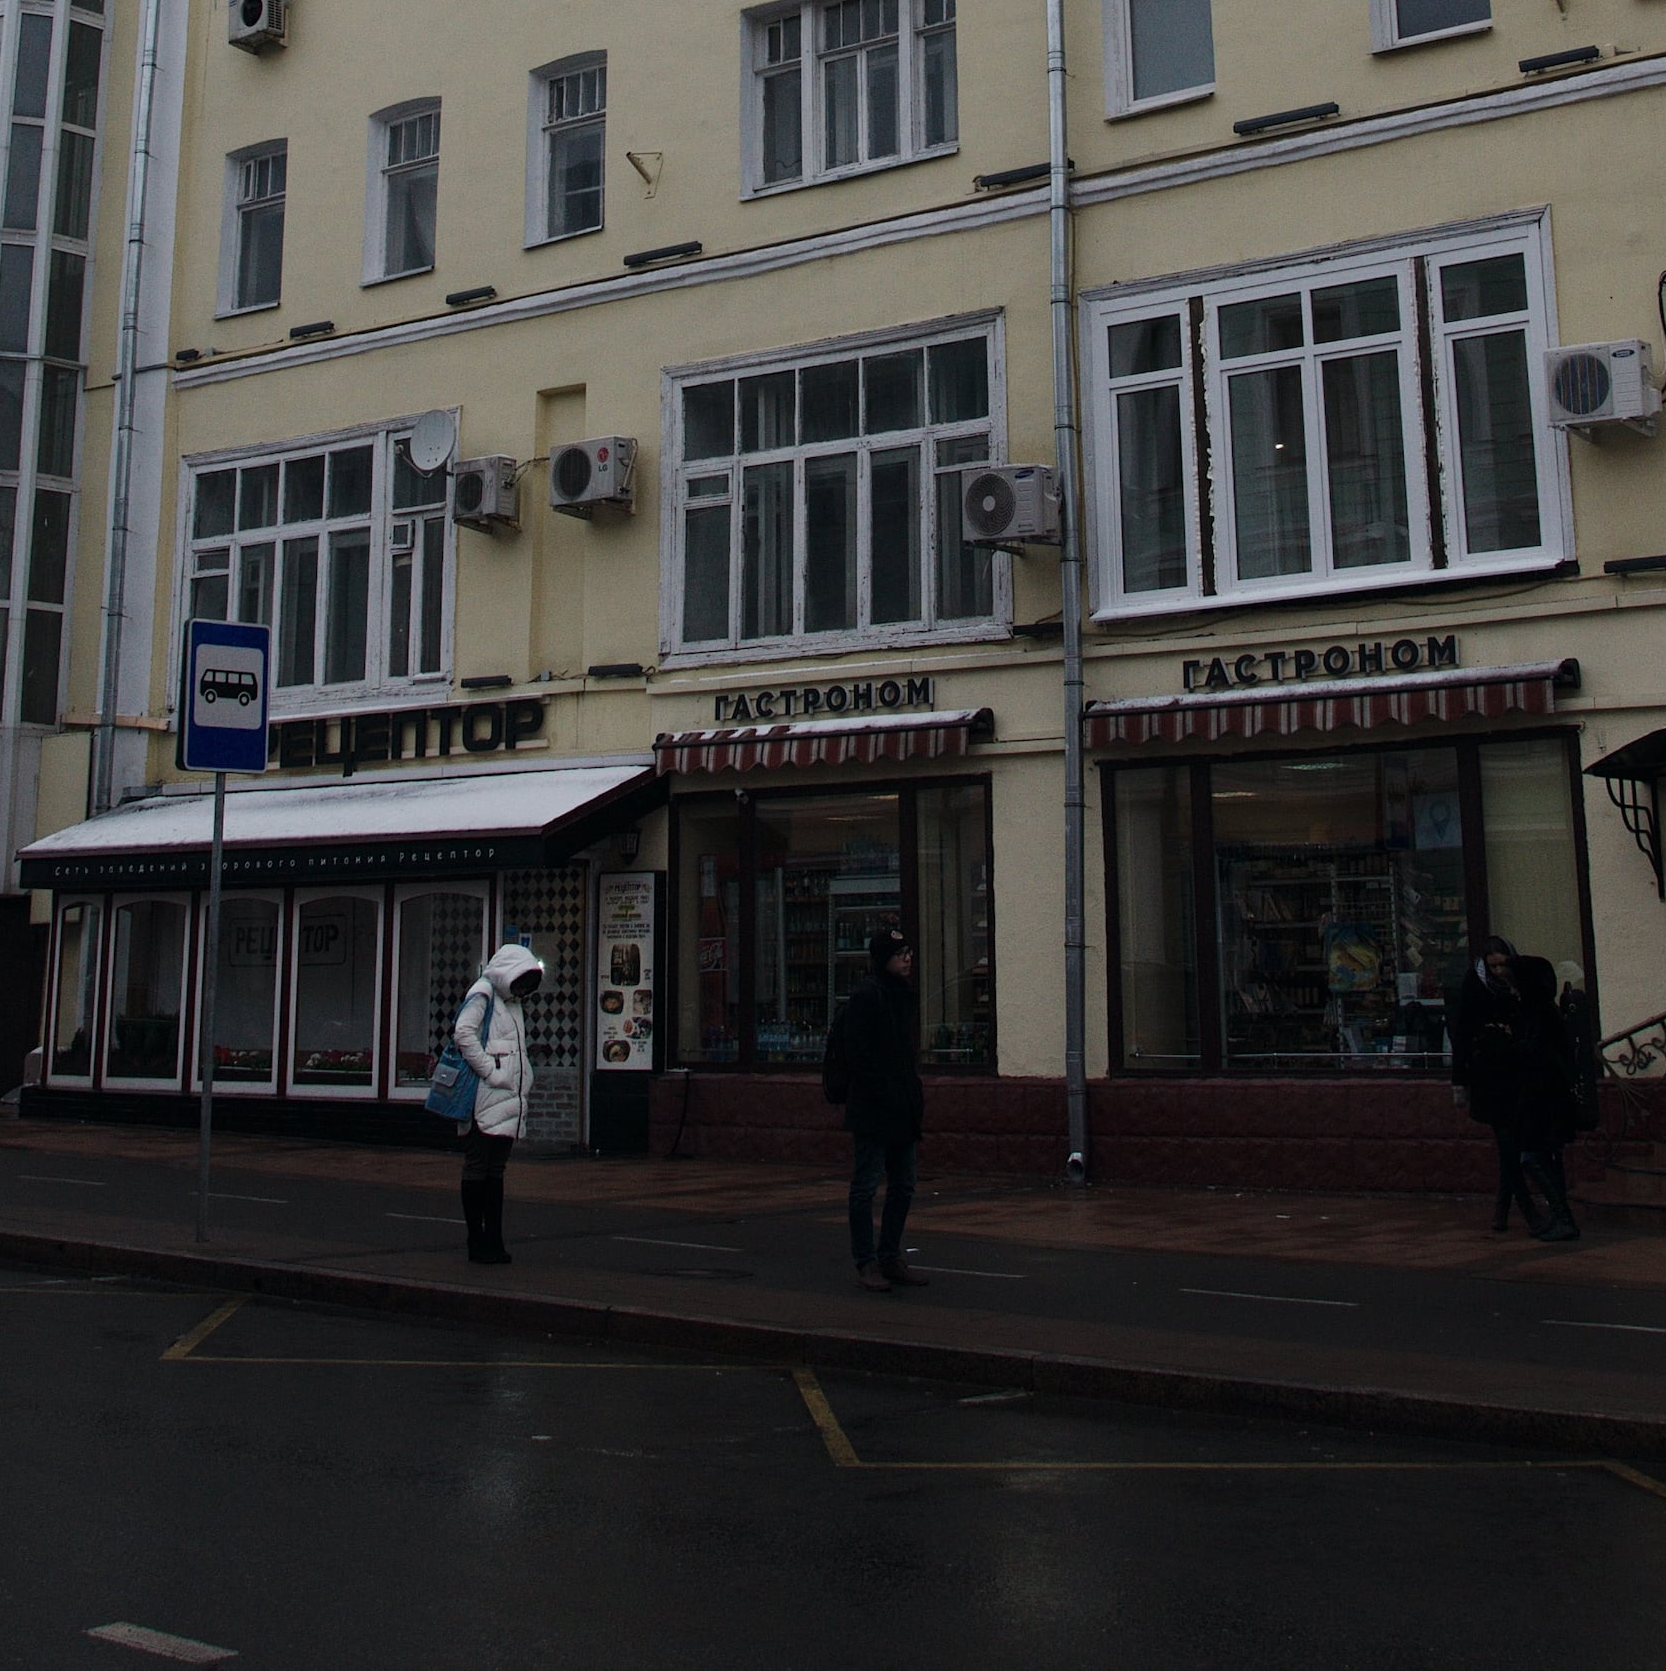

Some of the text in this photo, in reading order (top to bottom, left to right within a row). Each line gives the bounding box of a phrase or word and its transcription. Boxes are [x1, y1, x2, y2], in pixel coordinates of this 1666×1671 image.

[597, 463, 608, 472] LG
[1182, 634, 1460, 691] ГАСТРОНОМ
[714, 676, 933, 721] ГАСТРОНОМ
[54, 846, 496, 877] Сеть заведений зорового питания Рецептор
[235, 923, 339, 961] РЕЦТОР
